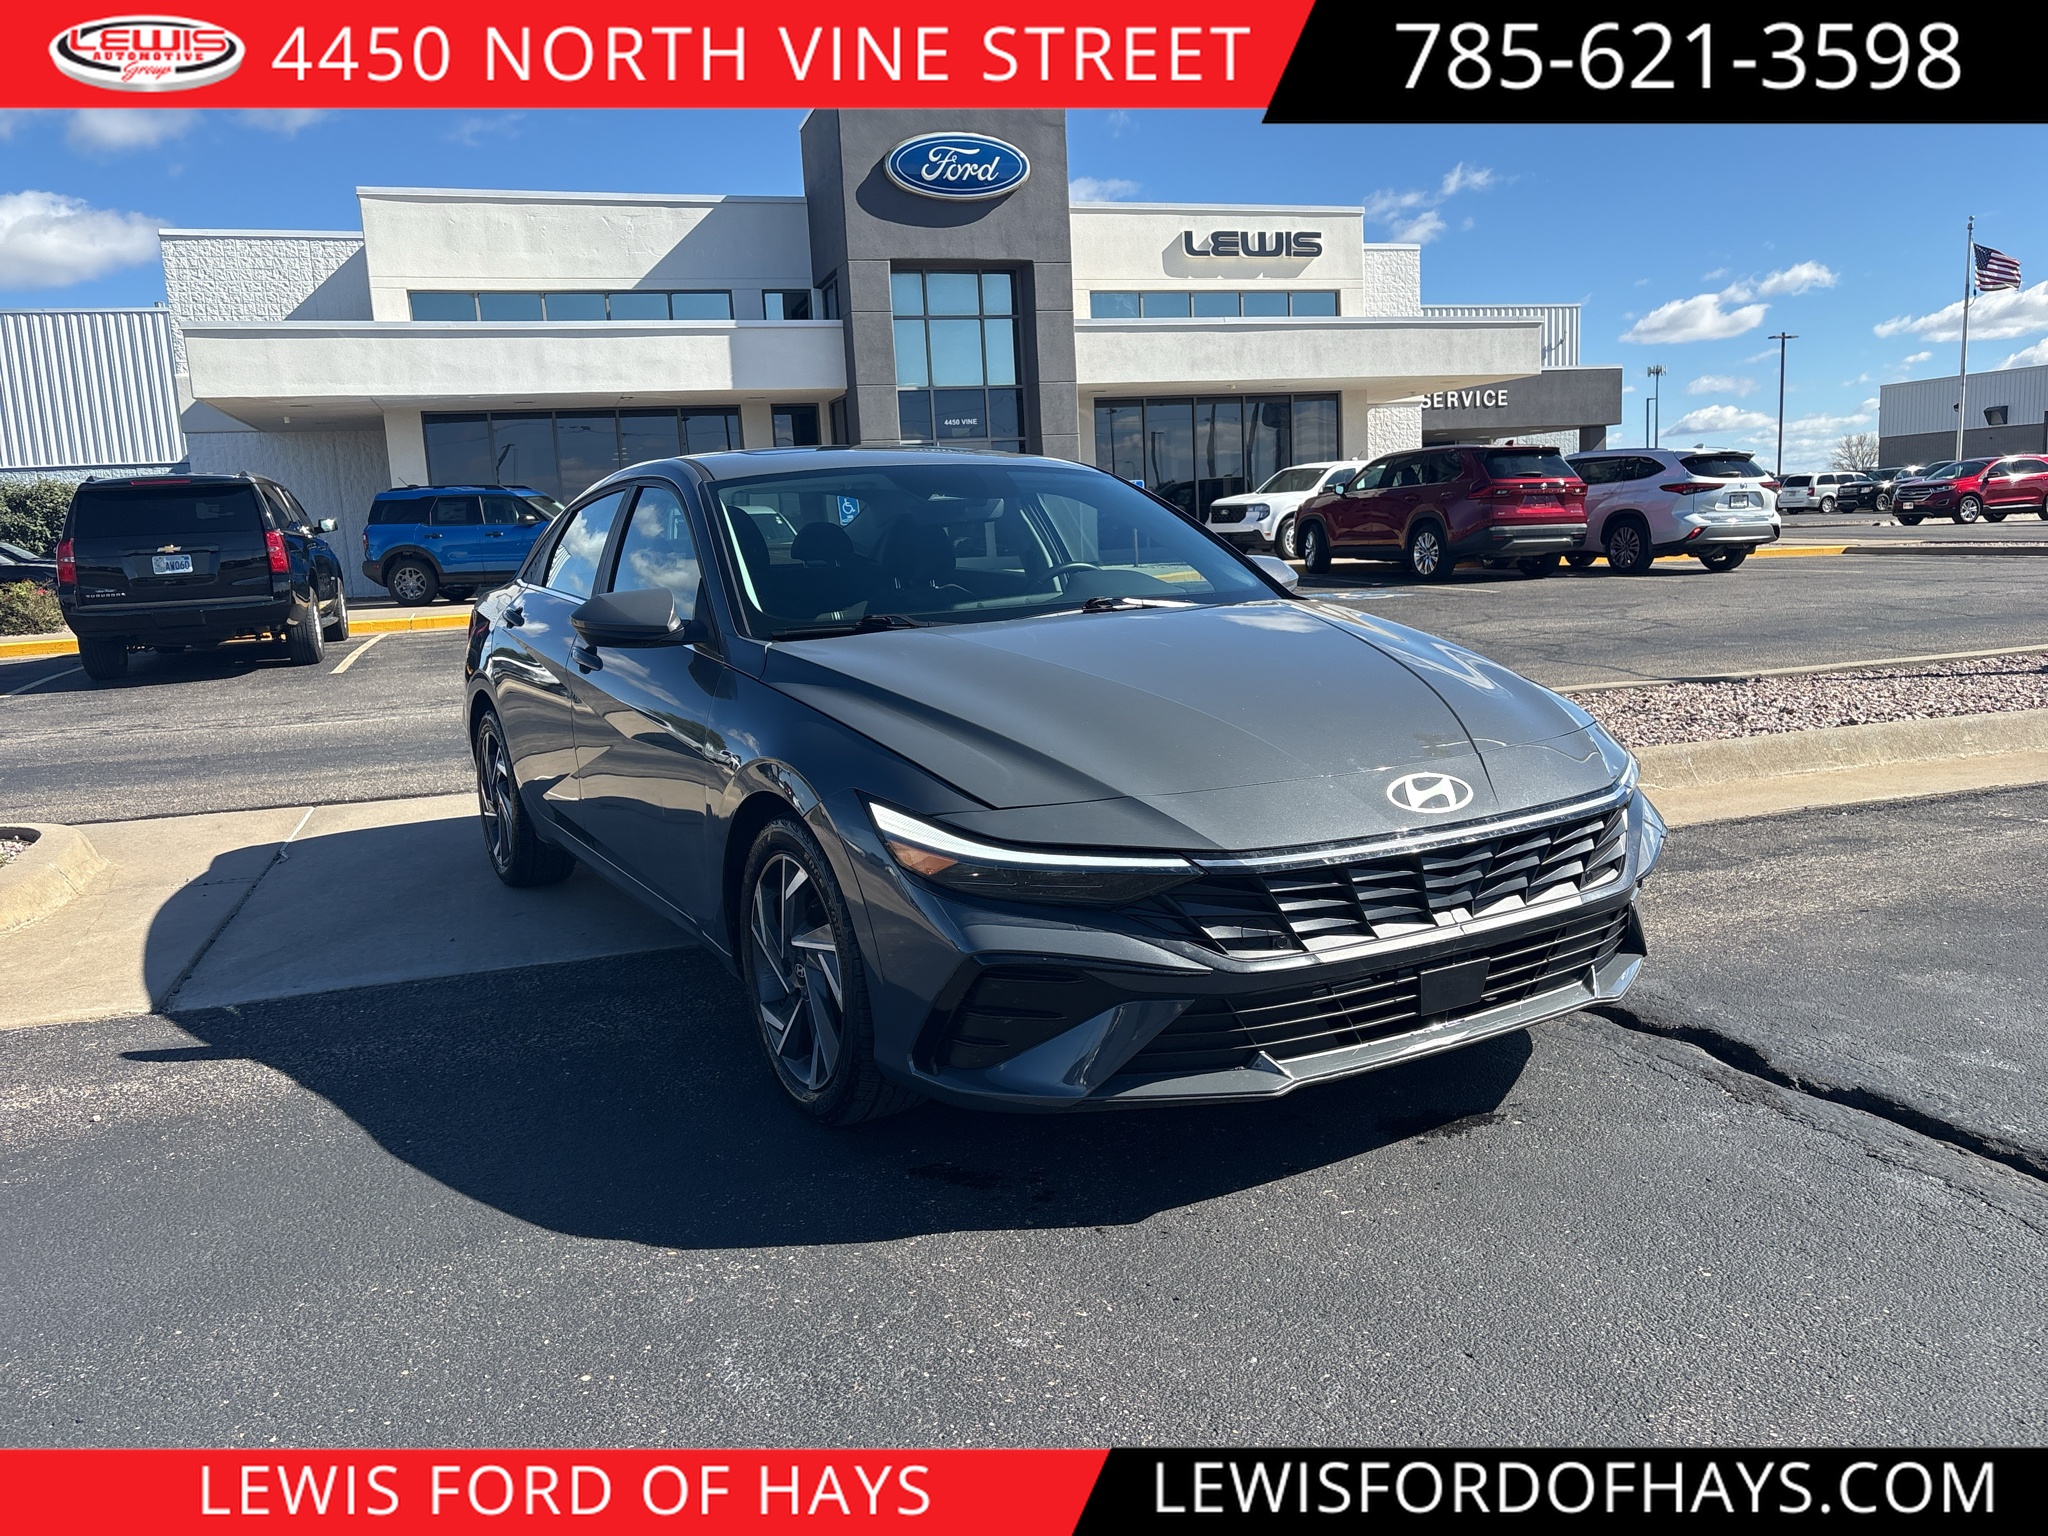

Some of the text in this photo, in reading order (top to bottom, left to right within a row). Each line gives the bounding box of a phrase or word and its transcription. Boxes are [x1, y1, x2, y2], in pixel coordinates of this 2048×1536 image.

[921, 146, 1000, 182] Ford
[1183, 230, 1323, 257] LEWIS
[1420, 389, 1509, 409] SERVICE
[943, 418, 961, 426] 4450
